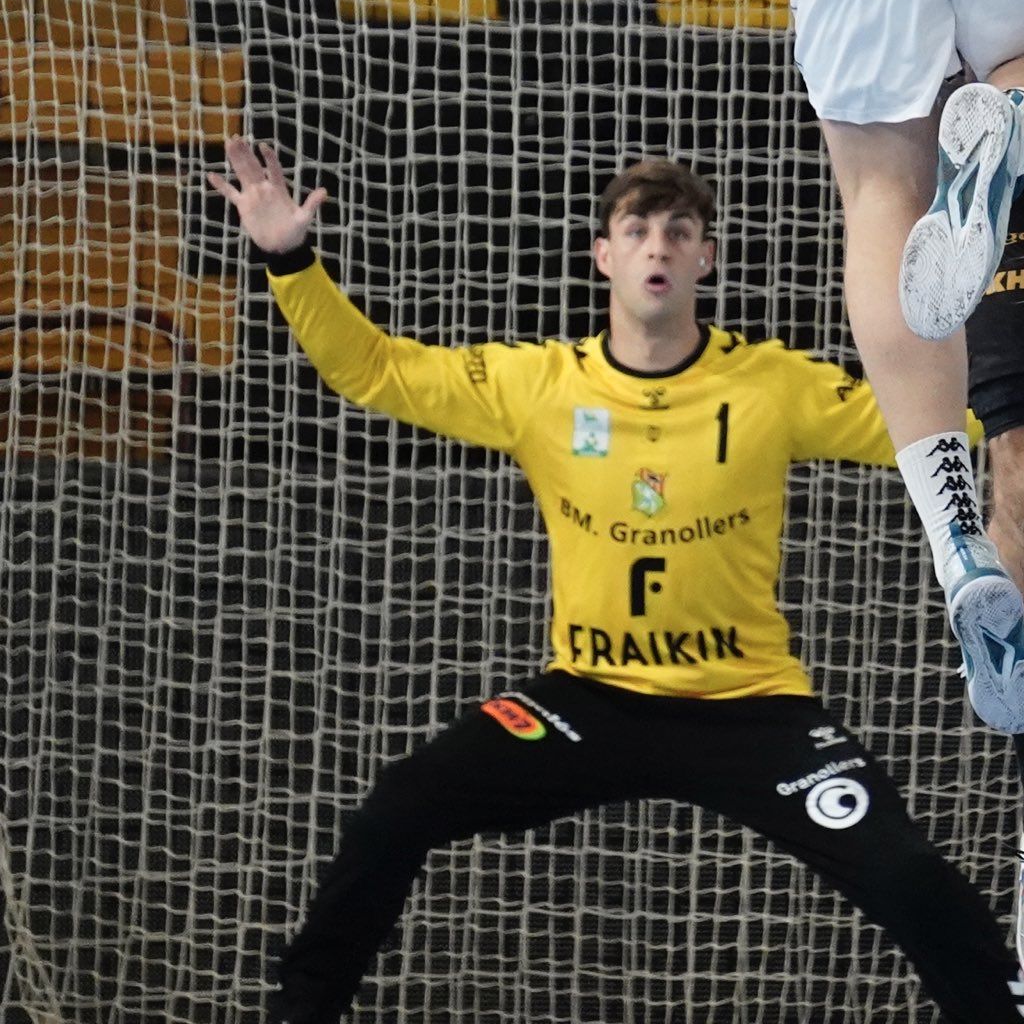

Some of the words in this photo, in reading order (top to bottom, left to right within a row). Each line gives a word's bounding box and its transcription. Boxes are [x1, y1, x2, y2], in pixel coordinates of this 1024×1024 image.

[715, 402, 730, 464] 1
[559, 496, 599, 536] BM.
[609, 507, 750, 546] Granollers
[568, 623, 745, 667] FRAIKIN
[776, 757, 866, 796] Granollers
